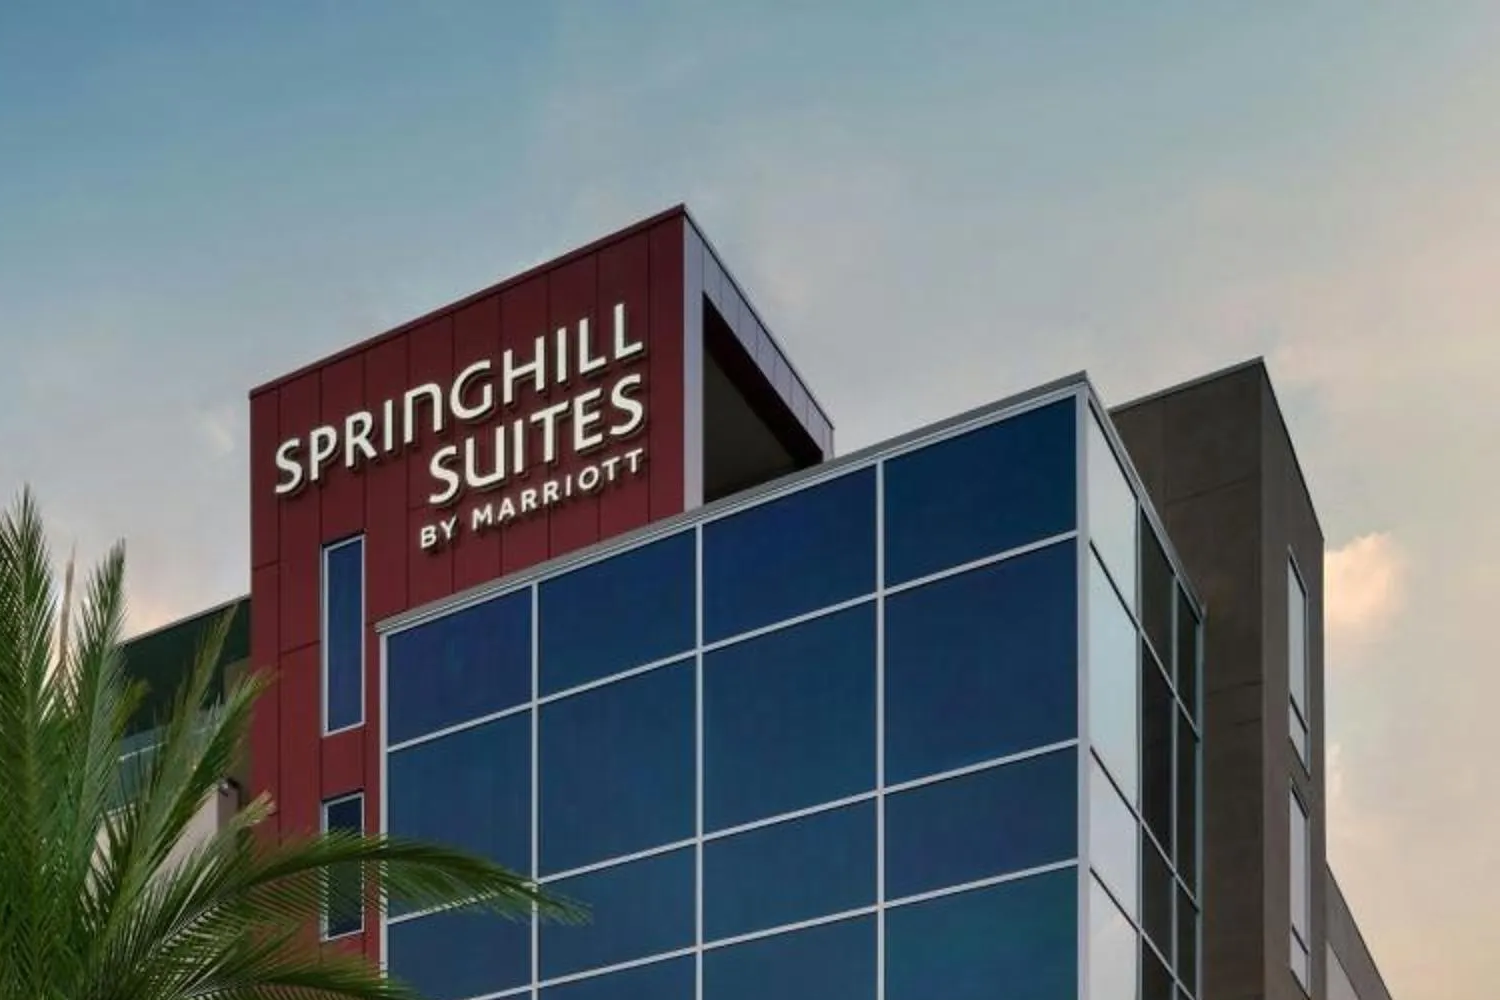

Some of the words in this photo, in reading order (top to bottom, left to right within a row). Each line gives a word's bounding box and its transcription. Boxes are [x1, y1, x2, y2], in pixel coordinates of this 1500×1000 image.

[275, 303, 643, 494] SPRINGHILL
[429, 374, 643, 504] SUITES
[421, 516, 457, 549] BY
[472, 448, 643, 530] MARRIOTT
